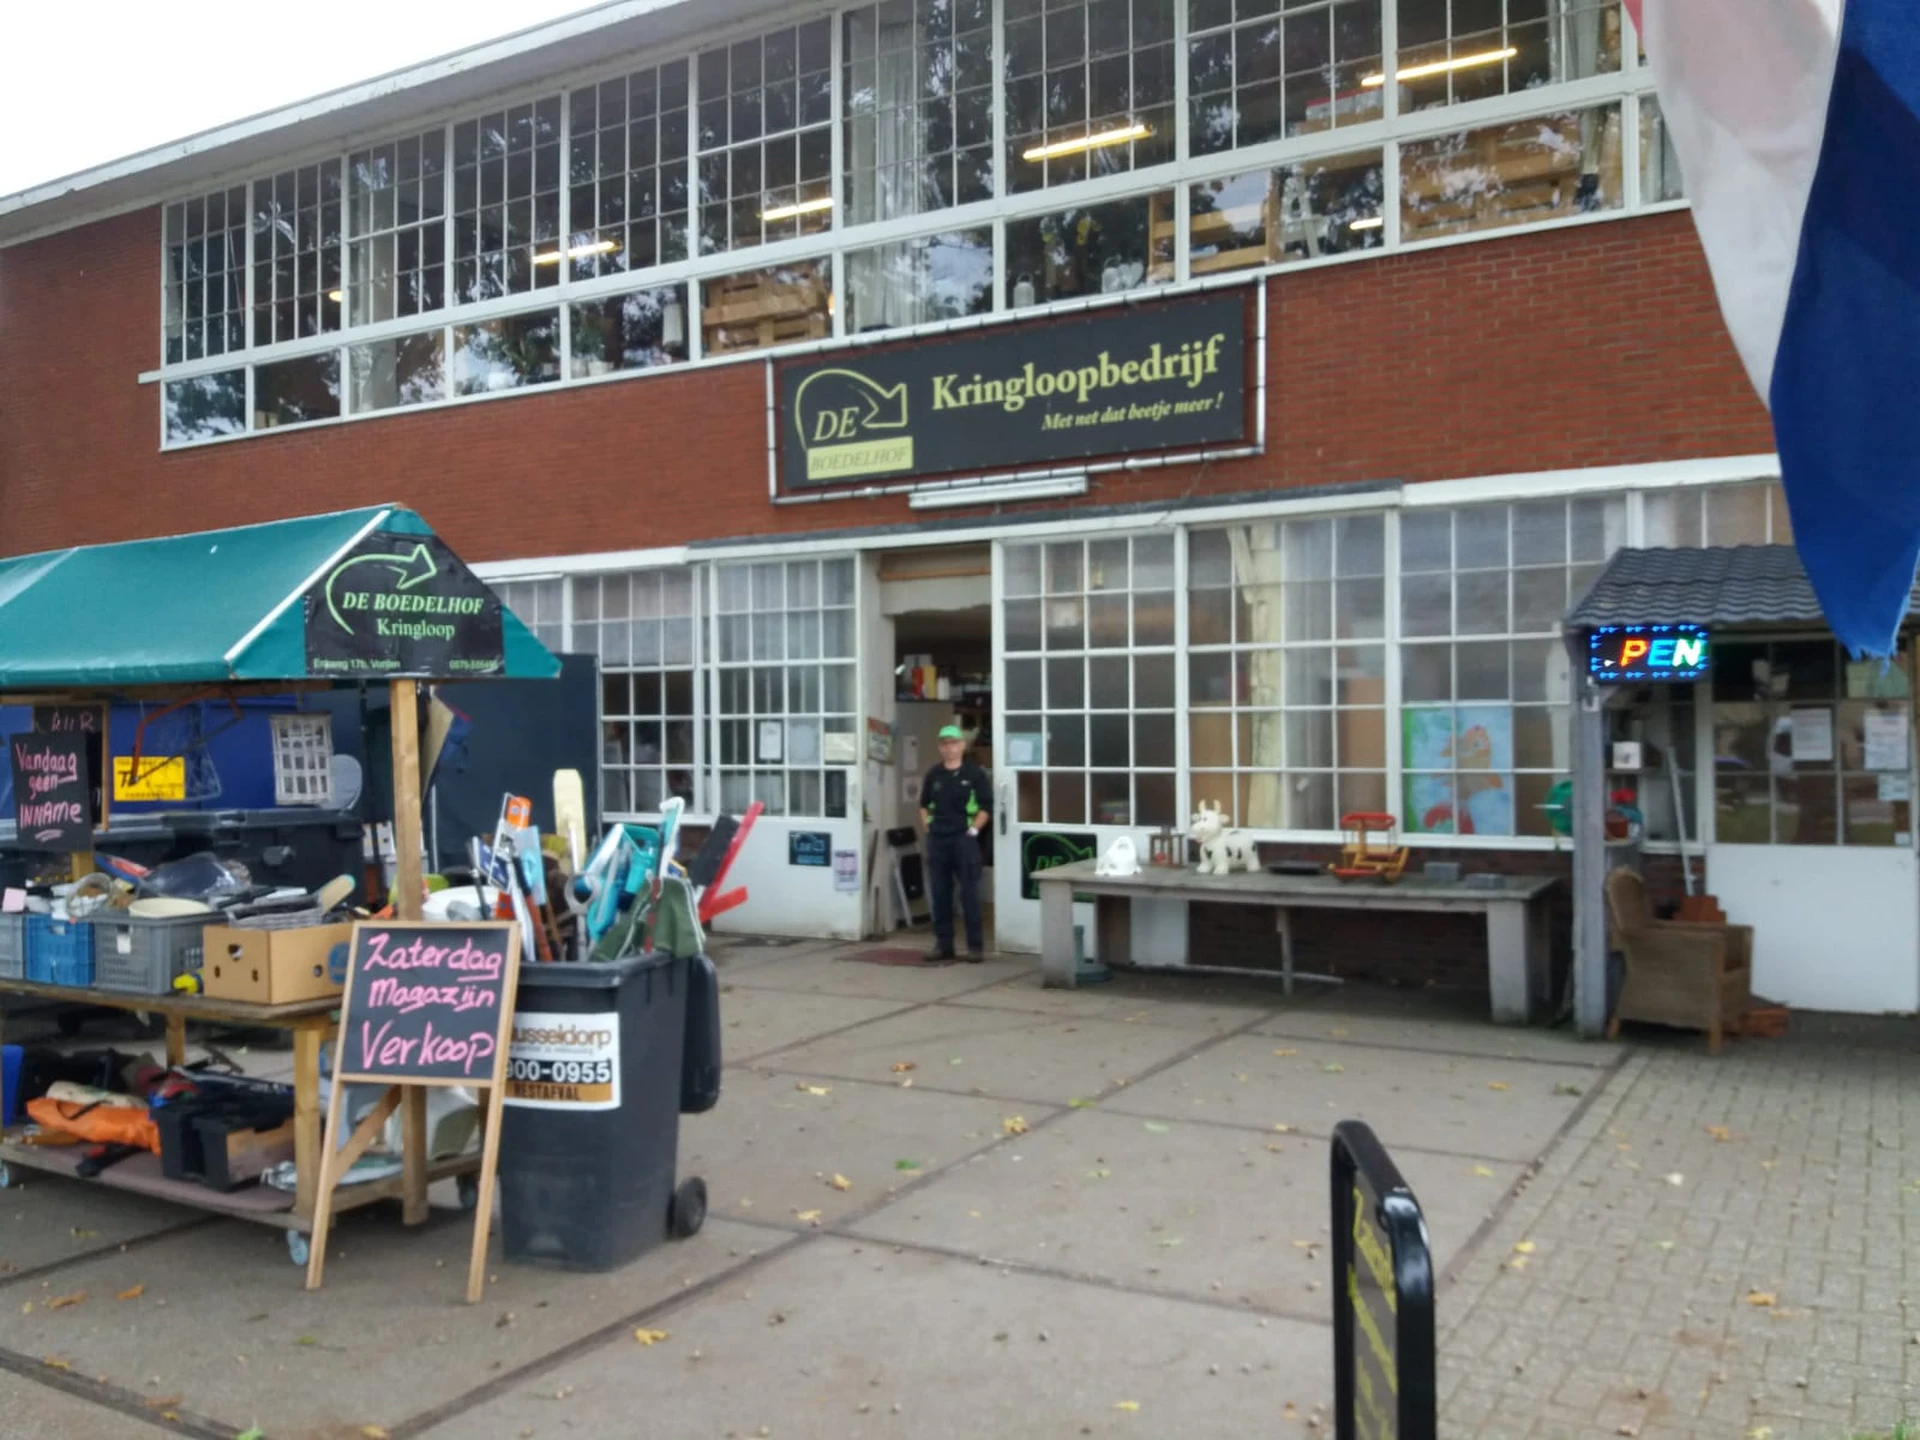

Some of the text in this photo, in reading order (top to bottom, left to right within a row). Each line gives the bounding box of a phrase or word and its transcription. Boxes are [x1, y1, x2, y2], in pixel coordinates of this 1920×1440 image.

[932, 333, 1224, 412] Kringloopbedrijf
[813, 407, 860, 441] DE
[1041, 413, 1073, 430] Met
[1075, 410, 1099, 426] net
[1101, 405, 1126, 423] dat
[1128, 399, 1172, 421] beetje
[810, 447, 910, 473] BOEDELHOF
[342, 592, 485, 614] DE BOEDELHOF
[376, 617, 456, 641] Kringloop
[15, 743, 78, 781] Vandaag
[362, 932, 502, 982] Zaterdag
[368, 977, 495, 1014] Magazijn
[362, 1019, 495, 1075] Verkoop
